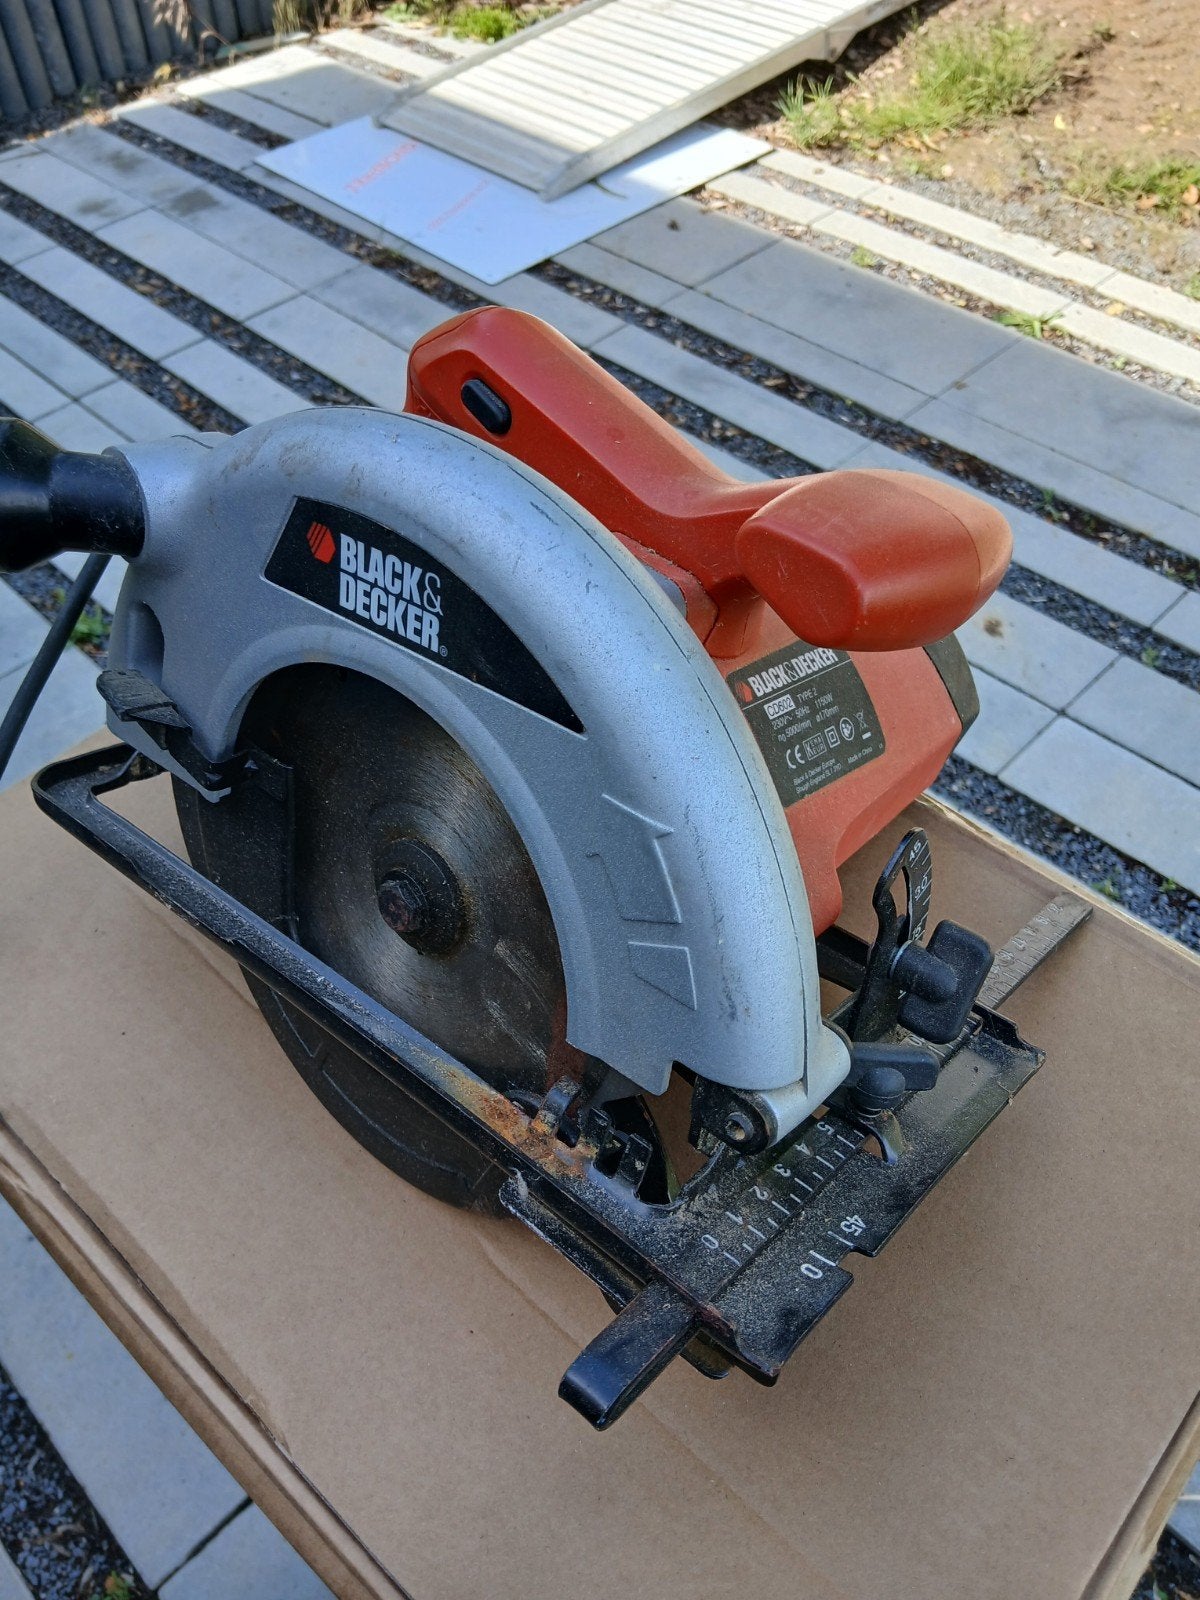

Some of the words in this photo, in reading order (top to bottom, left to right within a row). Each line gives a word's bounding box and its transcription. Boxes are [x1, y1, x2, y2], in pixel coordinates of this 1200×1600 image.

[339, 571, 440, 653] DECKER
[766, 698, 796, 718] CD602
[797, 690, 813, 704] TYPE
[812, 688, 818, 697] 2
[908, 839, 922, 861] 45
[914, 876, 928, 898] 30
[817, 1121, 835, 1137] 5
[795, 1142, 812, 1156] 4
[774, 1163, 791, 1178] 3
[749, 1185, 769, 1201] 2
[725, 1211, 744, 1225] 1
[839, 1214, 867, 1236] 45
[701, 1234, 719, 1249] 0
[800, 1263, 823, 1279] 0
